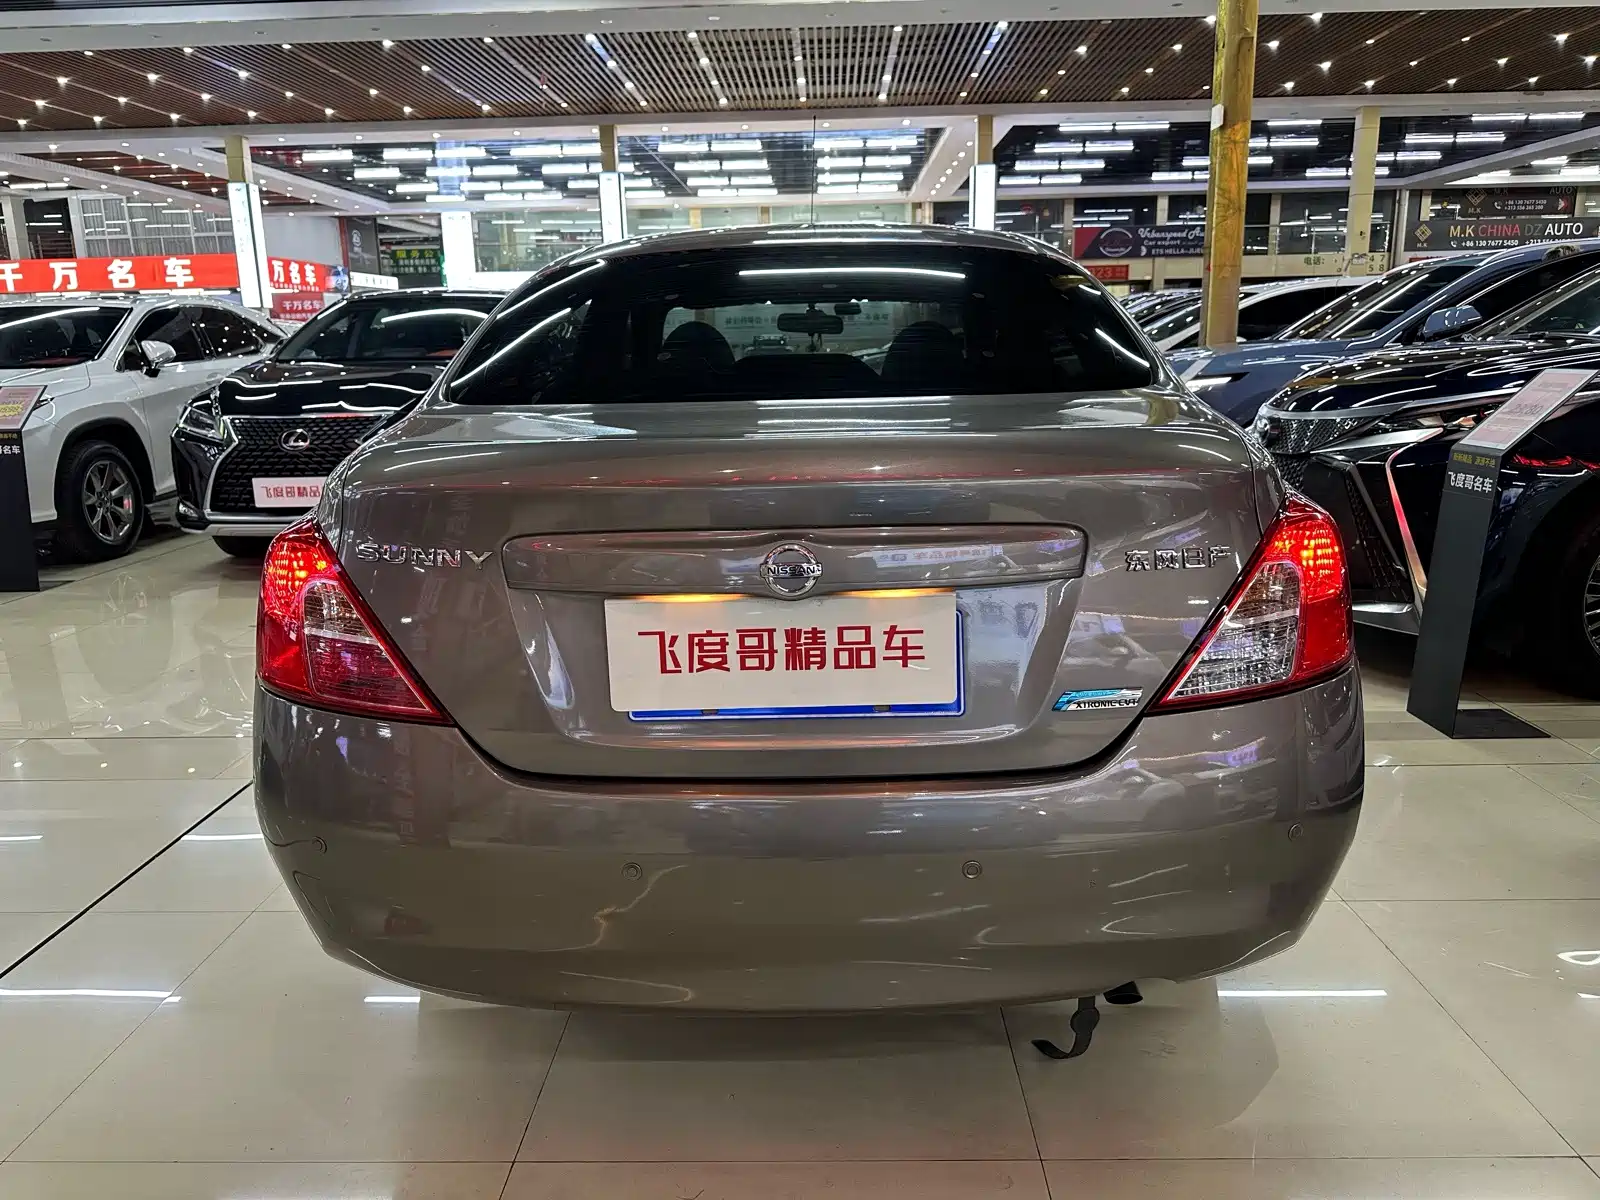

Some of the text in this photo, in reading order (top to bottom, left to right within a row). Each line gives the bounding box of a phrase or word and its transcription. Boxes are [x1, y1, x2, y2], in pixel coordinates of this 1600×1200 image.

[1449, 222, 1583, 238] M.K CHINA DZ AUTO
[0, 257, 195, 292] 千万名车
[272, 259, 317, 286] 万名车
[0, 445, 21, 455] 名车
[1448, 471, 1494, 494] 飞度哥名车
[355, 542, 493, 571] SUNNY
[1125, 544, 1232, 572] 东风日产
[767, 565, 816, 576] NISSAN
[637, 624, 926, 674] 飞度哥精品车
[1075, 700, 1117, 709] XTRONIC
